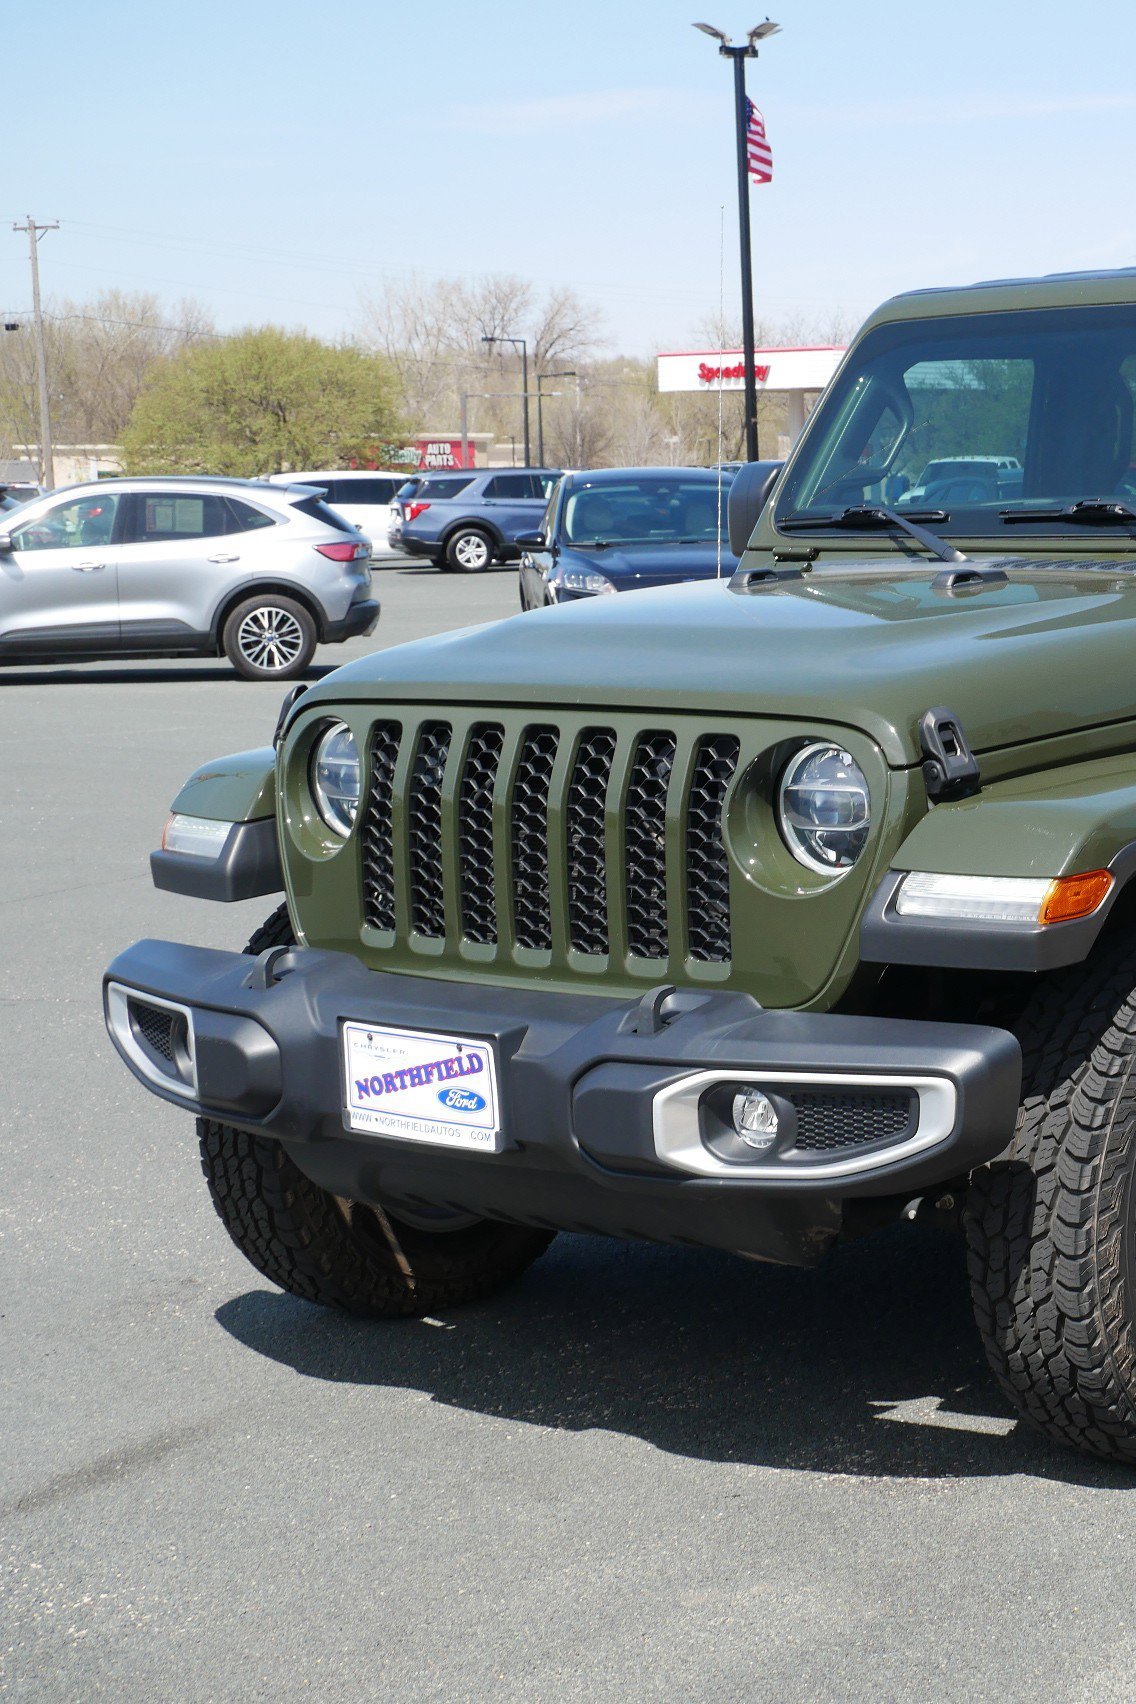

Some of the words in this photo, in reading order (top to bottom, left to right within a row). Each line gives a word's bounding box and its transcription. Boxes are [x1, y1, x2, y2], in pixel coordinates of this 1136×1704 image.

[427, 443, 451, 454] AUTO
[424, 454, 454, 467] PARTS
[354, 1053, 484, 1100] NORTHFIELD
[446, 1089, 478, 1110] Ford
